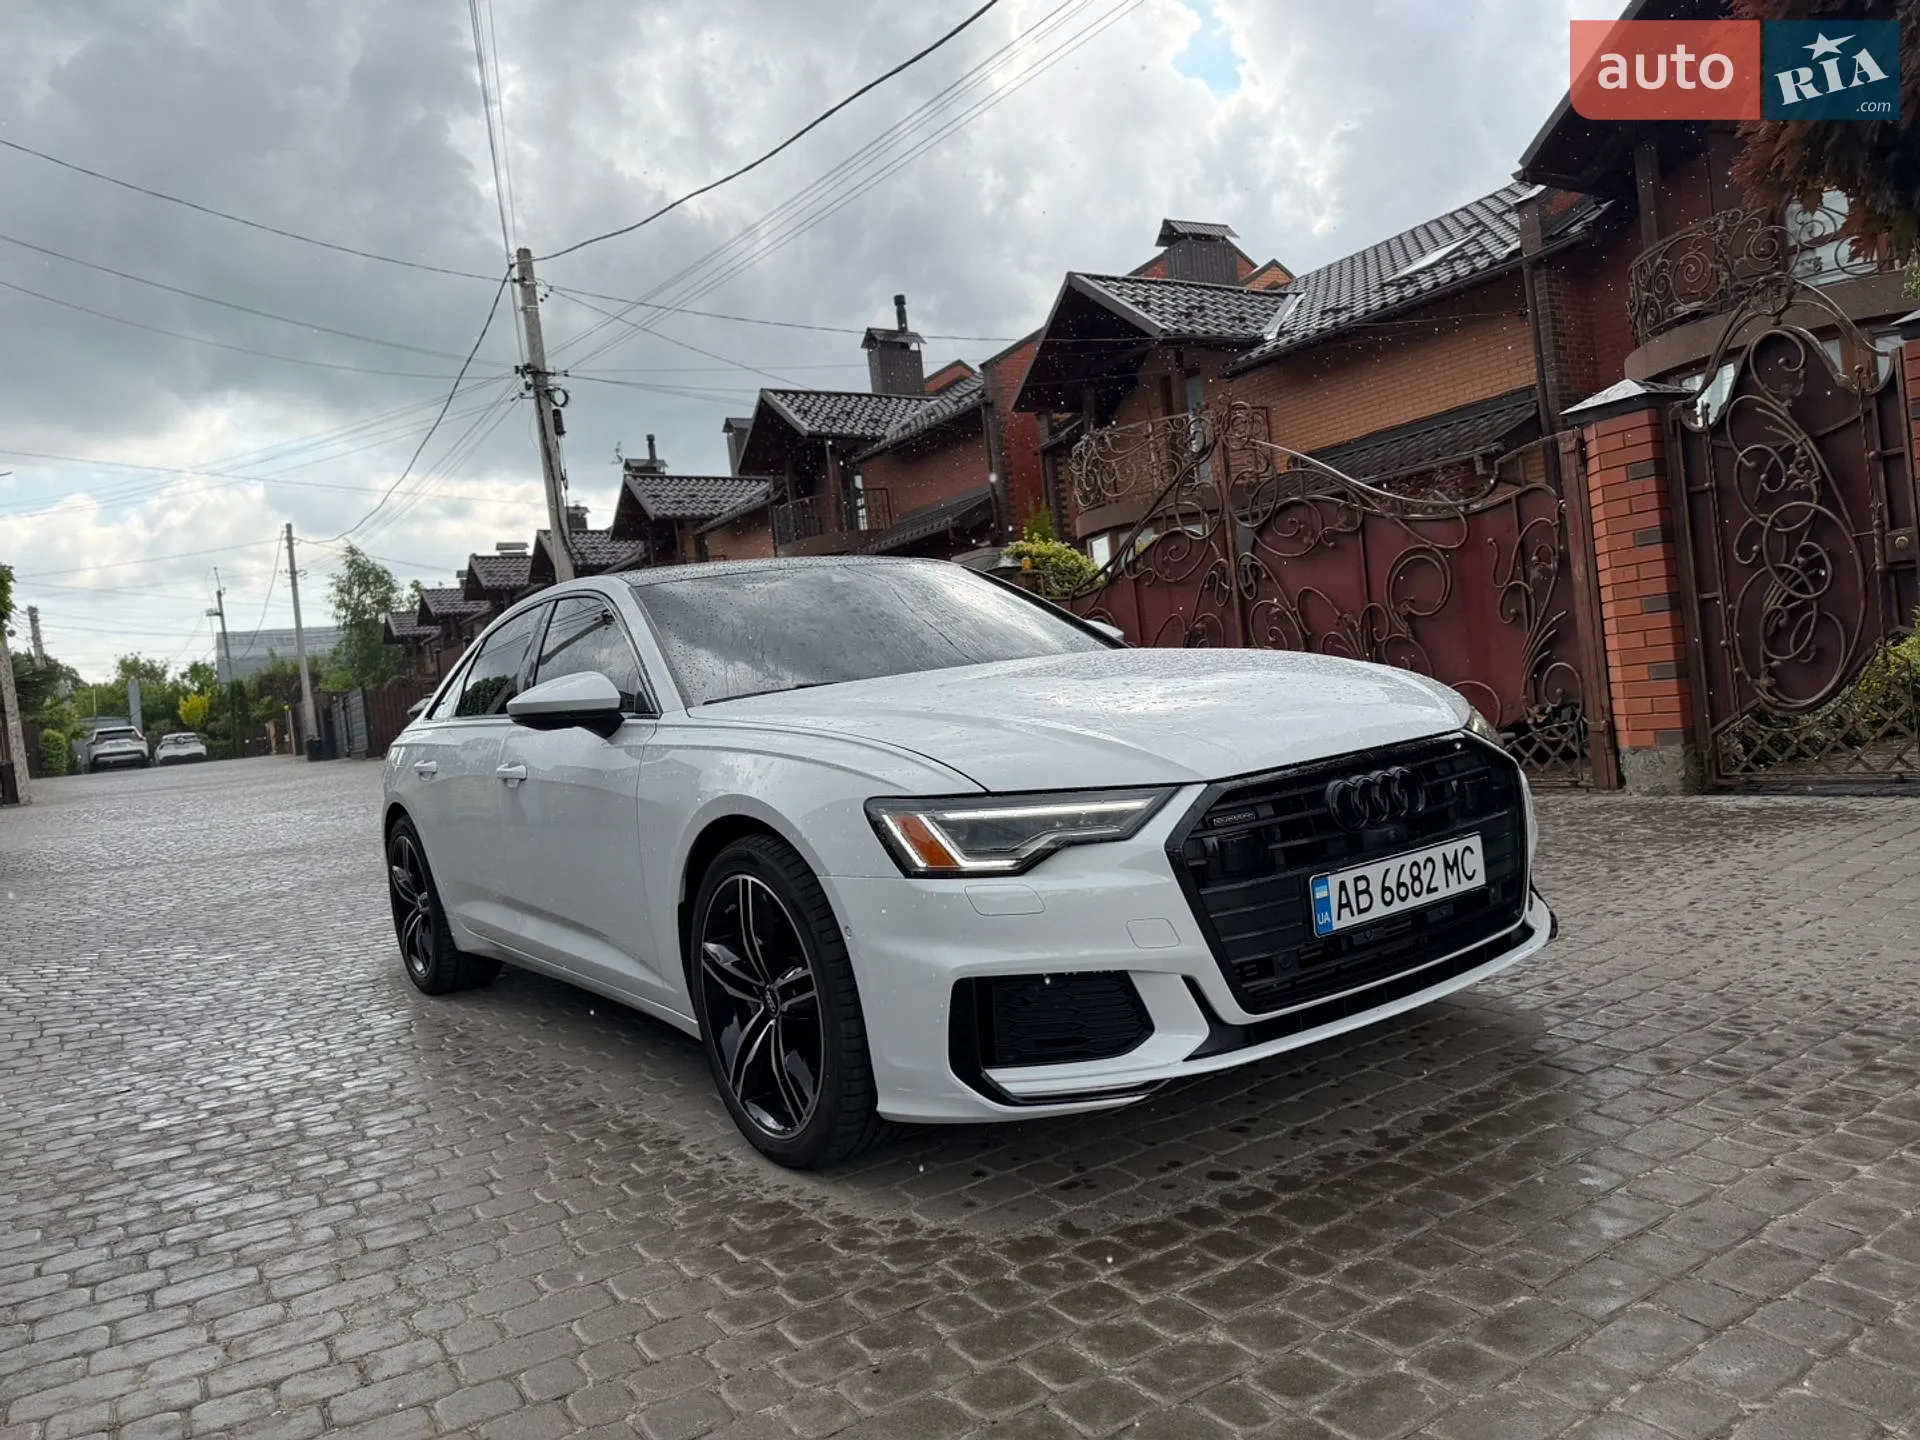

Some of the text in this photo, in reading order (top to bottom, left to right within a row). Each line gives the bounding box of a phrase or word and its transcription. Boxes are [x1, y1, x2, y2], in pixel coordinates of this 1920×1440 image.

[1337, 845, 1477, 921] AB 6682 MC
[1317, 912, 1331, 925] UA
